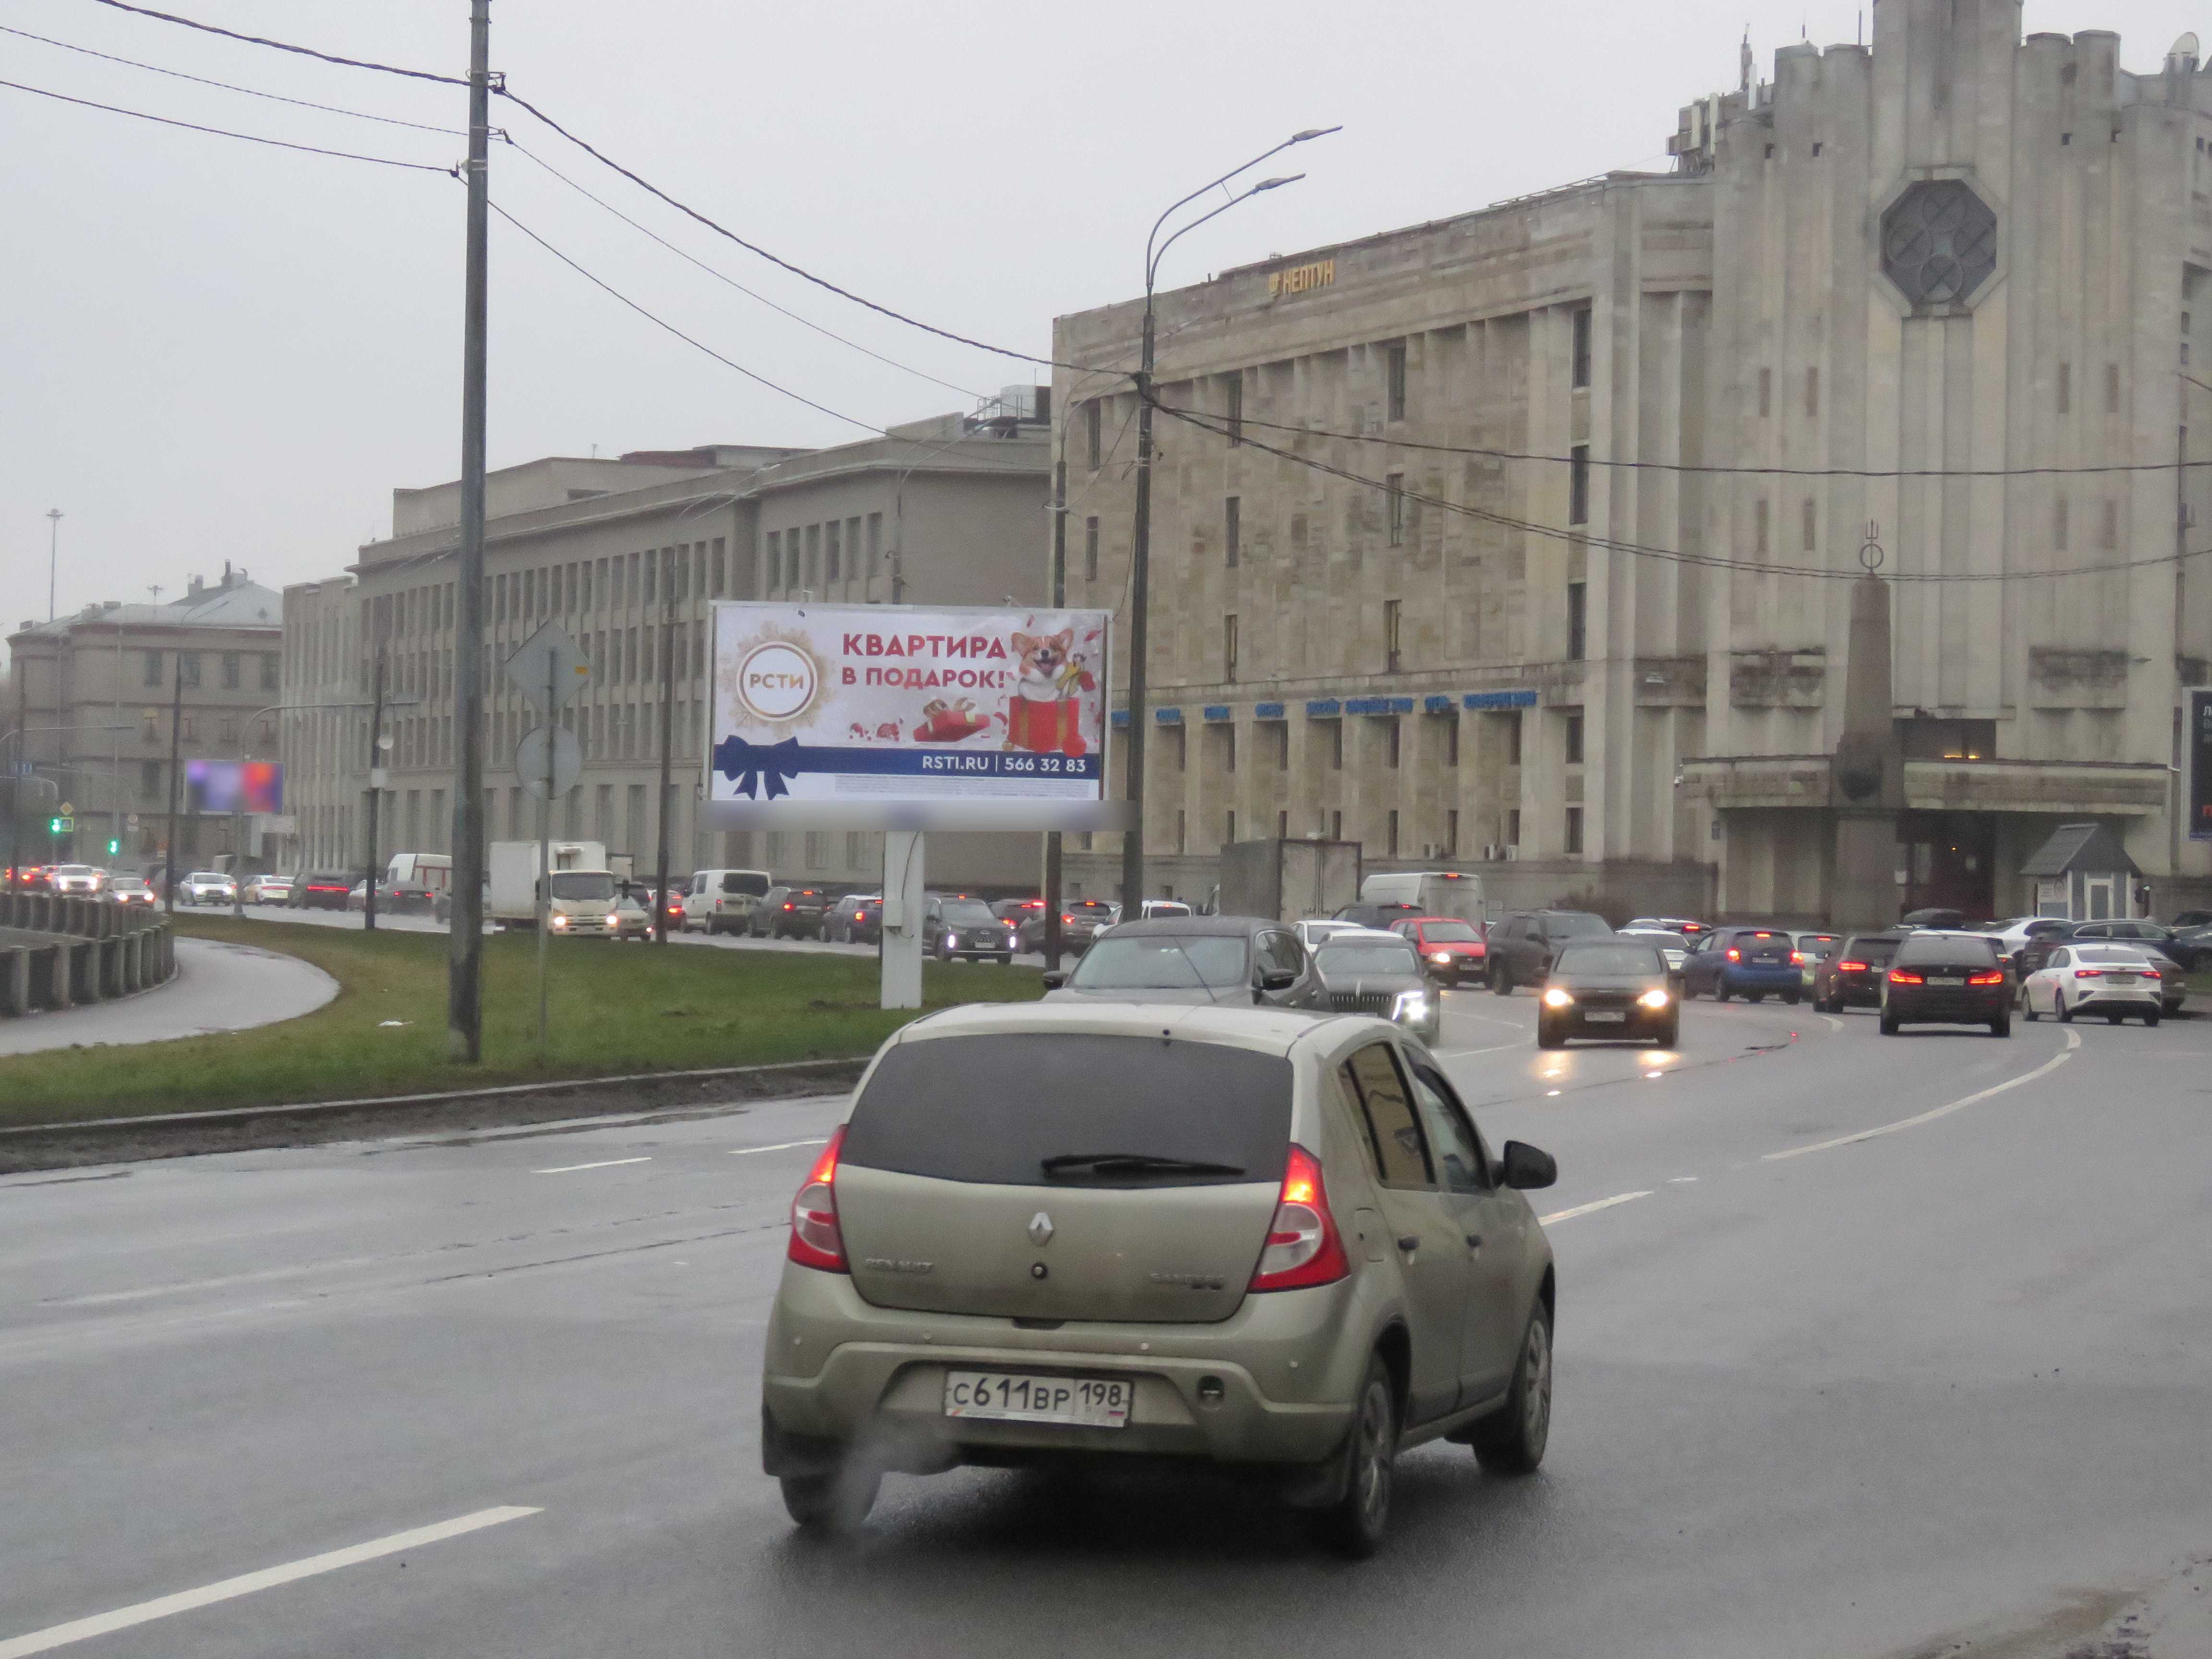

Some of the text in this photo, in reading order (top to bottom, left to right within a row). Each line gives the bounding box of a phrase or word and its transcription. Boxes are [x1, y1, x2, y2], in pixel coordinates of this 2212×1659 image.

[1282, 259, 1335, 294] НЕПТУН
[843, 633, 1007, 659] КВАРТИРА
[750, 673, 804, 689] РСТИ
[842, 667, 1005, 690] В ПОДАРОК!
[922, 756, 1086, 772] RSTI.RU 566 32 83
[953, 1377, 1122, 1411] С611ВР 198
